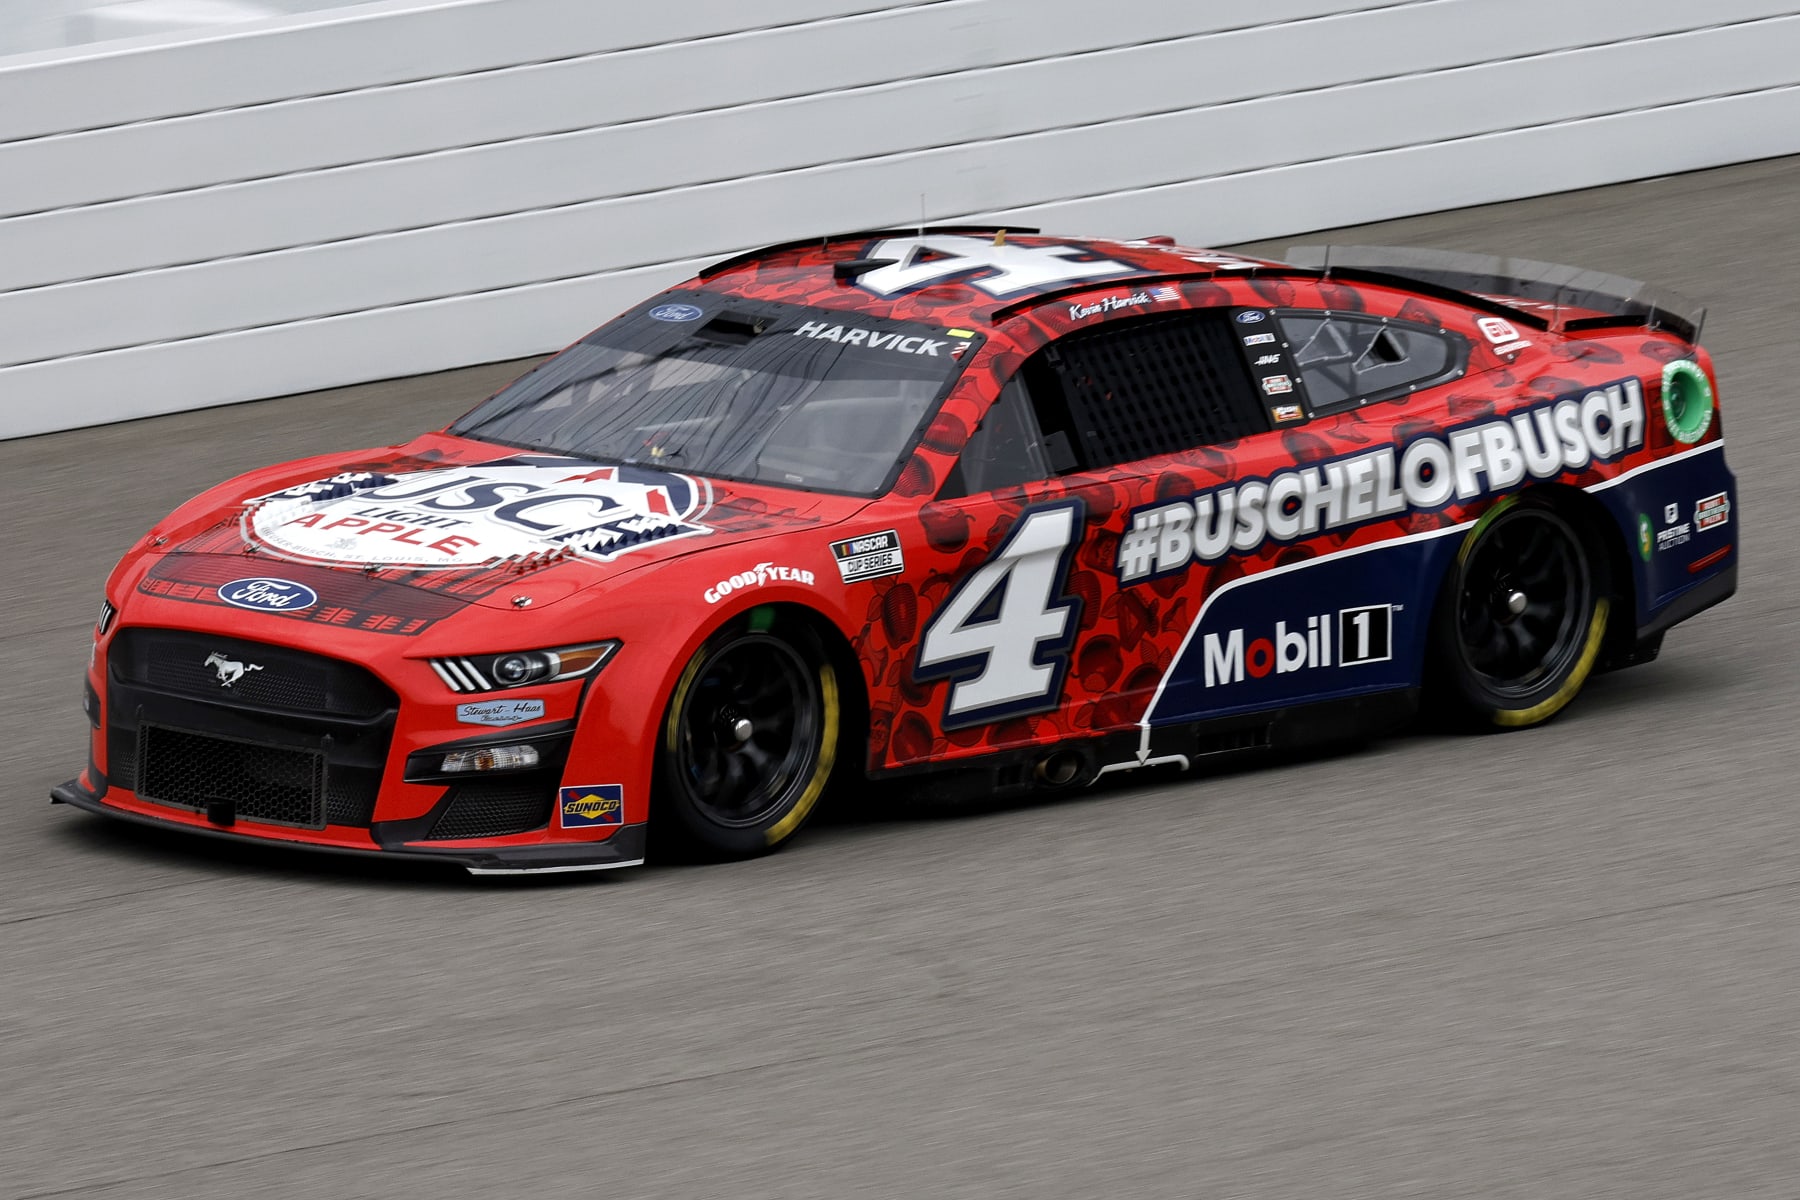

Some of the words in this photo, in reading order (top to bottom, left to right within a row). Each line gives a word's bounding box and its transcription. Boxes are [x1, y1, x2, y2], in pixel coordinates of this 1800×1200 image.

[856, 234, 1136, 297] 4
[793, 321, 948, 356] HARVICK
[1118, 379, 1645, 582] #BUSCHELOFBUSCH
[281, 514, 481, 556] APPLE
[352, 507, 470, 529] LIGHT
[848, 559, 863, 573] CUP
[864, 553, 893, 570] SERIES
[853, 535, 888, 554] NASCAR
[231, 580, 301, 608] Ford
[704, 562, 815, 604] GOODYEAR
[919, 506, 1074, 716] 4
[1203, 614, 1331, 688] Mobil
[566, 800, 617, 813] SUNOCO
